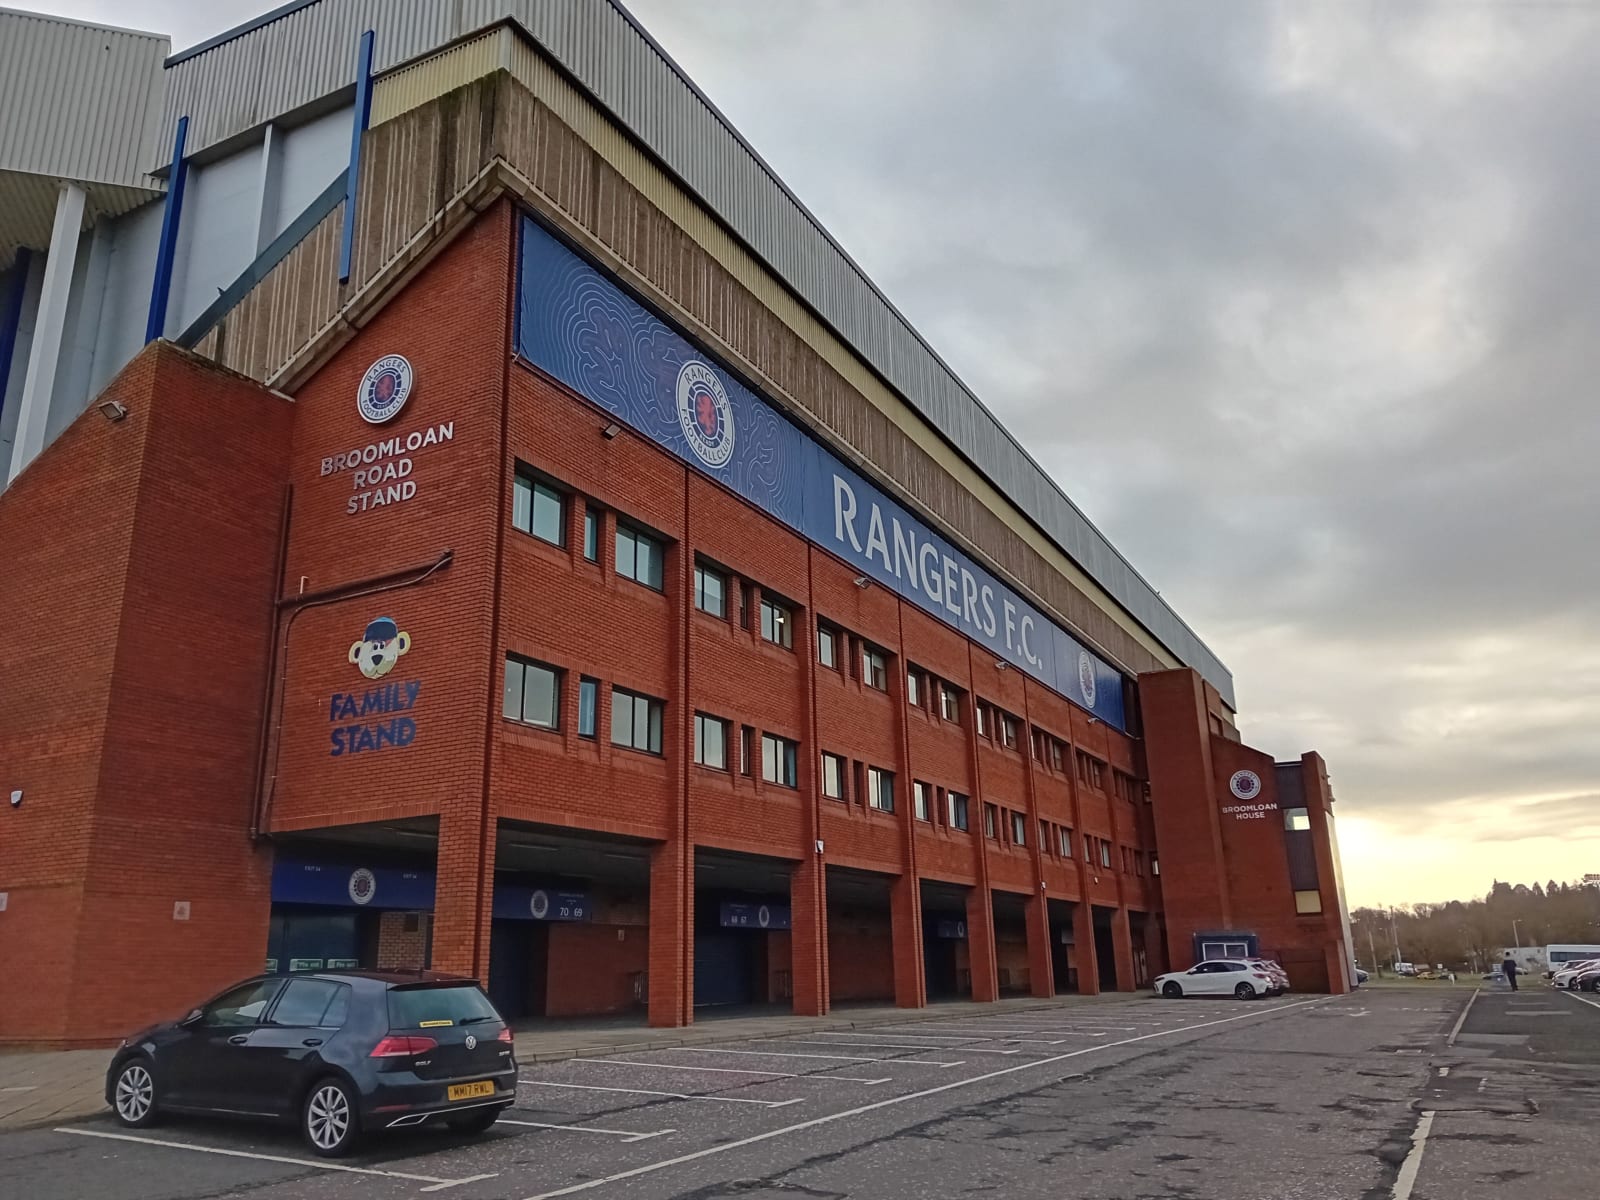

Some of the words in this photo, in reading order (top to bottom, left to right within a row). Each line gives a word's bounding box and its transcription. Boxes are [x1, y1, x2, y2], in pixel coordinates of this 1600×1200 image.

[366, 359, 406, 383] RANGERS
[362, 398, 392, 418] FOOTBALL
[392, 387, 407, 409] CLUB
[684, 367, 727, 411] RANGERS
[320, 421, 454, 477] BROOMLOAN
[681, 408, 717, 462] FOOTBALL
[717, 437, 732, 460] CLUB
[353, 458, 413, 490] ROAD
[346, 480, 417, 515] STAND
[832, 473, 998, 638] RANGERS
[1003, 598, 1044, 671] F.C.
[329, 679, 422, 722] FAMILY
[330, 717, 417, 757] STAND
[1222, 803, 1277, 813] BROOMLOAN
[1236, 812, 1265, 820] HOUSE
[560, 907, 569, 917] 70
[574, 907, 583, 917] 69
